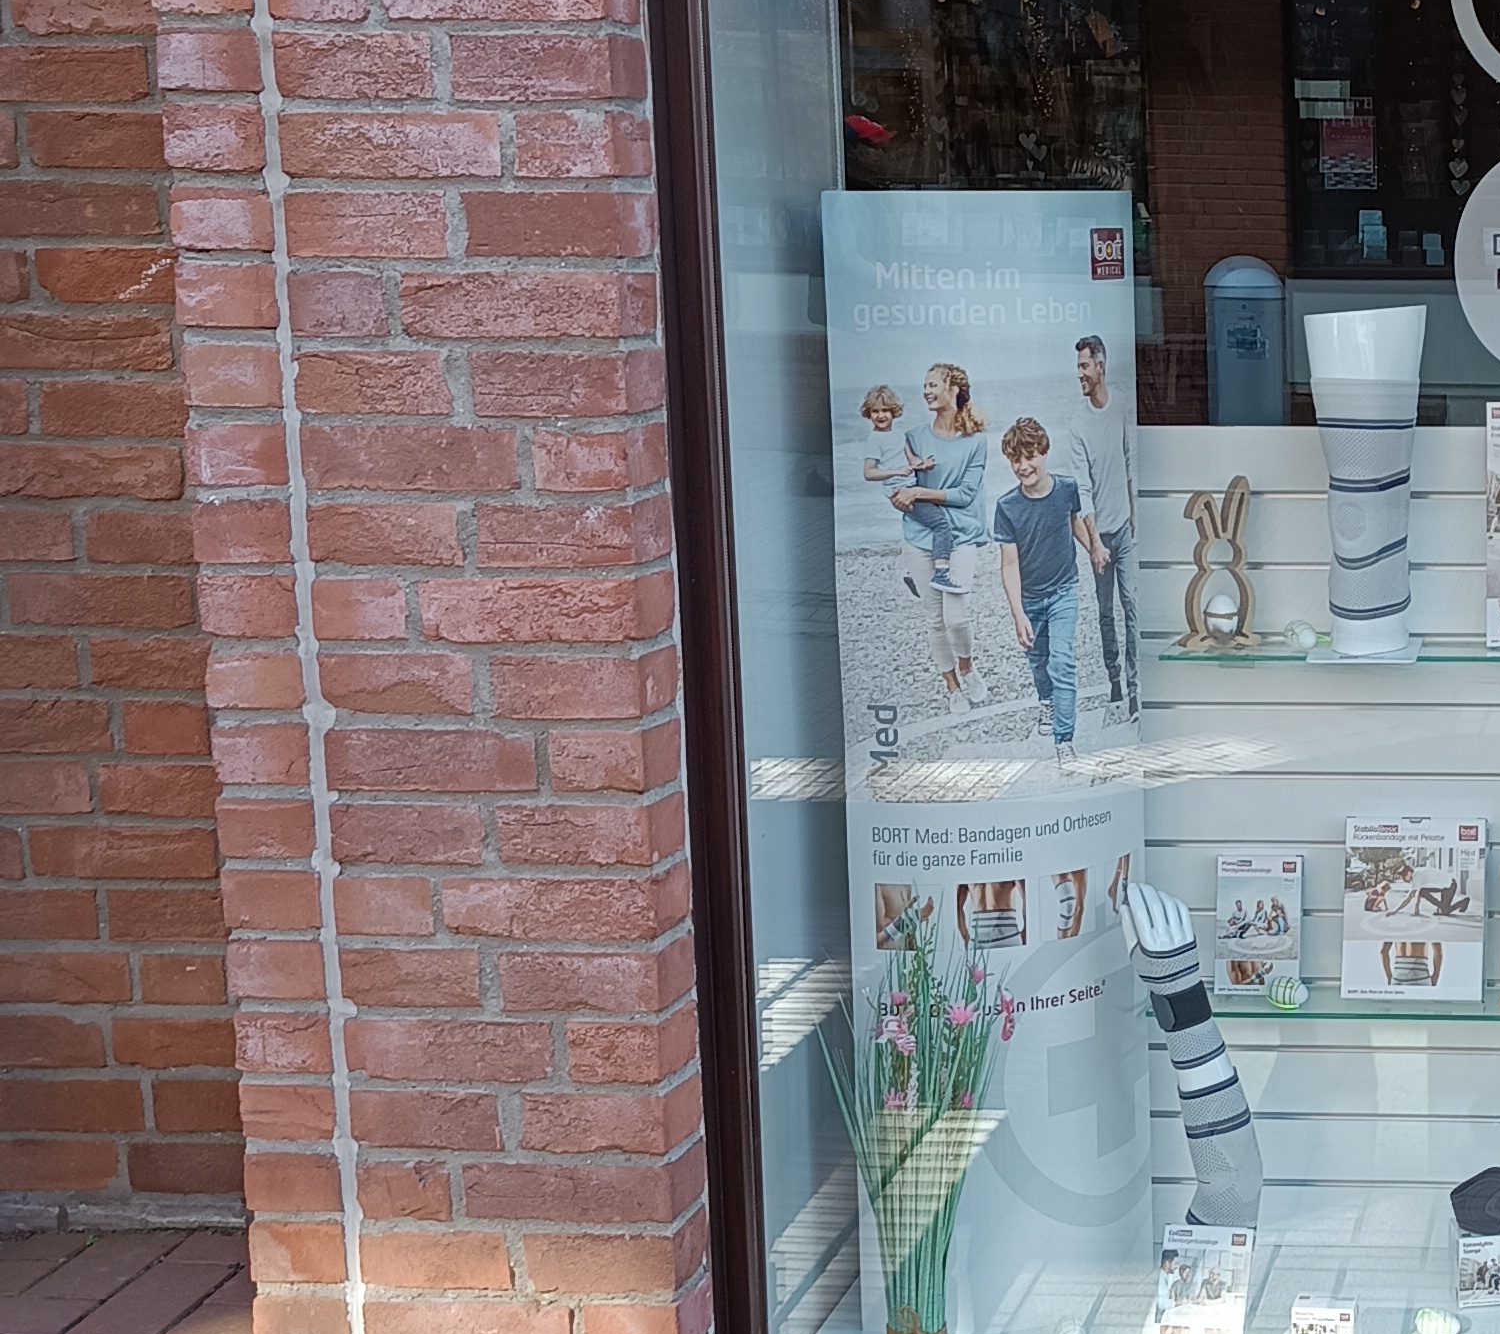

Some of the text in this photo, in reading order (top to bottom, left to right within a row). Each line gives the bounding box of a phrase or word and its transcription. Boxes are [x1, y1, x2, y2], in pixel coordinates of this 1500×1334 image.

[874, 261, 1021, 290] Mitten im
[853, 296, 1092, 332] gesunden Leben
[867, 704, 898, 777] Med
[871, 809, 1112, 845] BORT Med: Bandagen und Orthesen
[872, 847, 1023, 870] für die ganze Familie
[1030, 993, 1066, 1011] Ihrer
